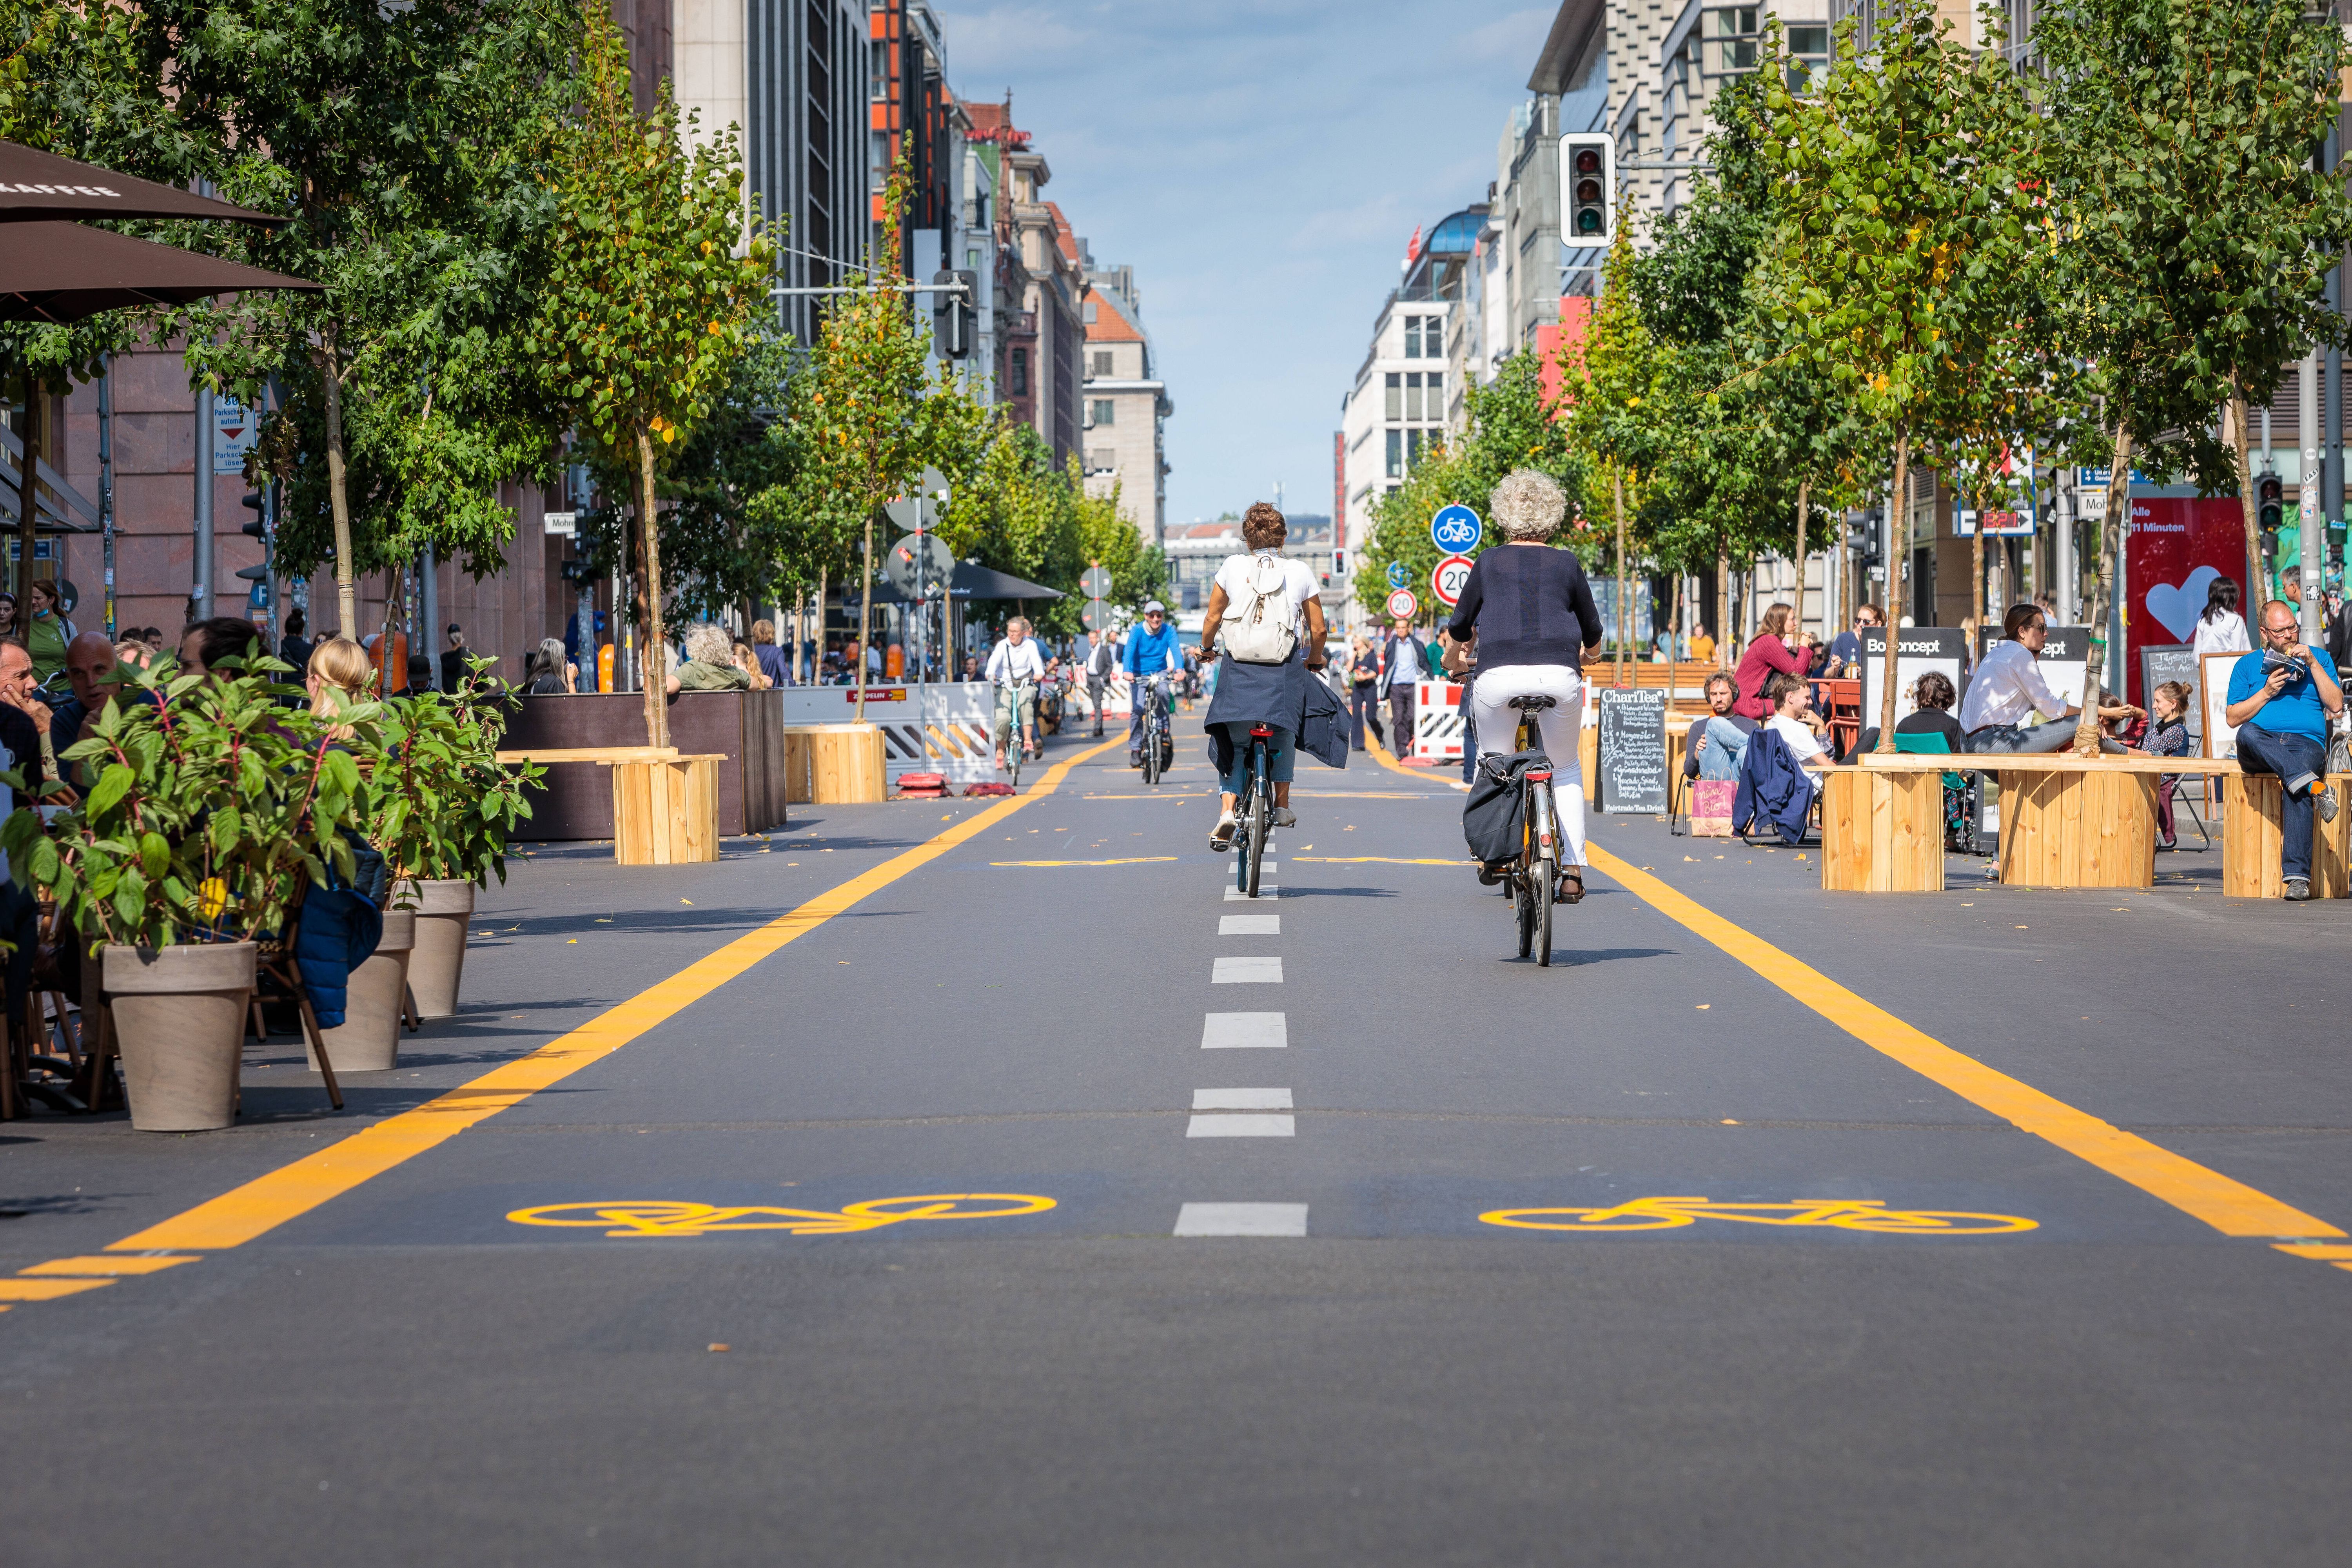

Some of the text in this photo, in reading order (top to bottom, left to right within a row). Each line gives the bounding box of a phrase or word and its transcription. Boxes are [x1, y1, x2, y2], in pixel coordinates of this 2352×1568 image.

[2304, 467, 2319, 481] EASY
[2132, 506, 2151, 516] Alle
[2132, 522, 2185, 532] 11 Minuten
[1445, 572, 1469, 590] 20
[1395, 598, 1409, 610] 20
[1602, 690, 1659, 703] ChariTea
[1695, 784, 1724, 801] mein
